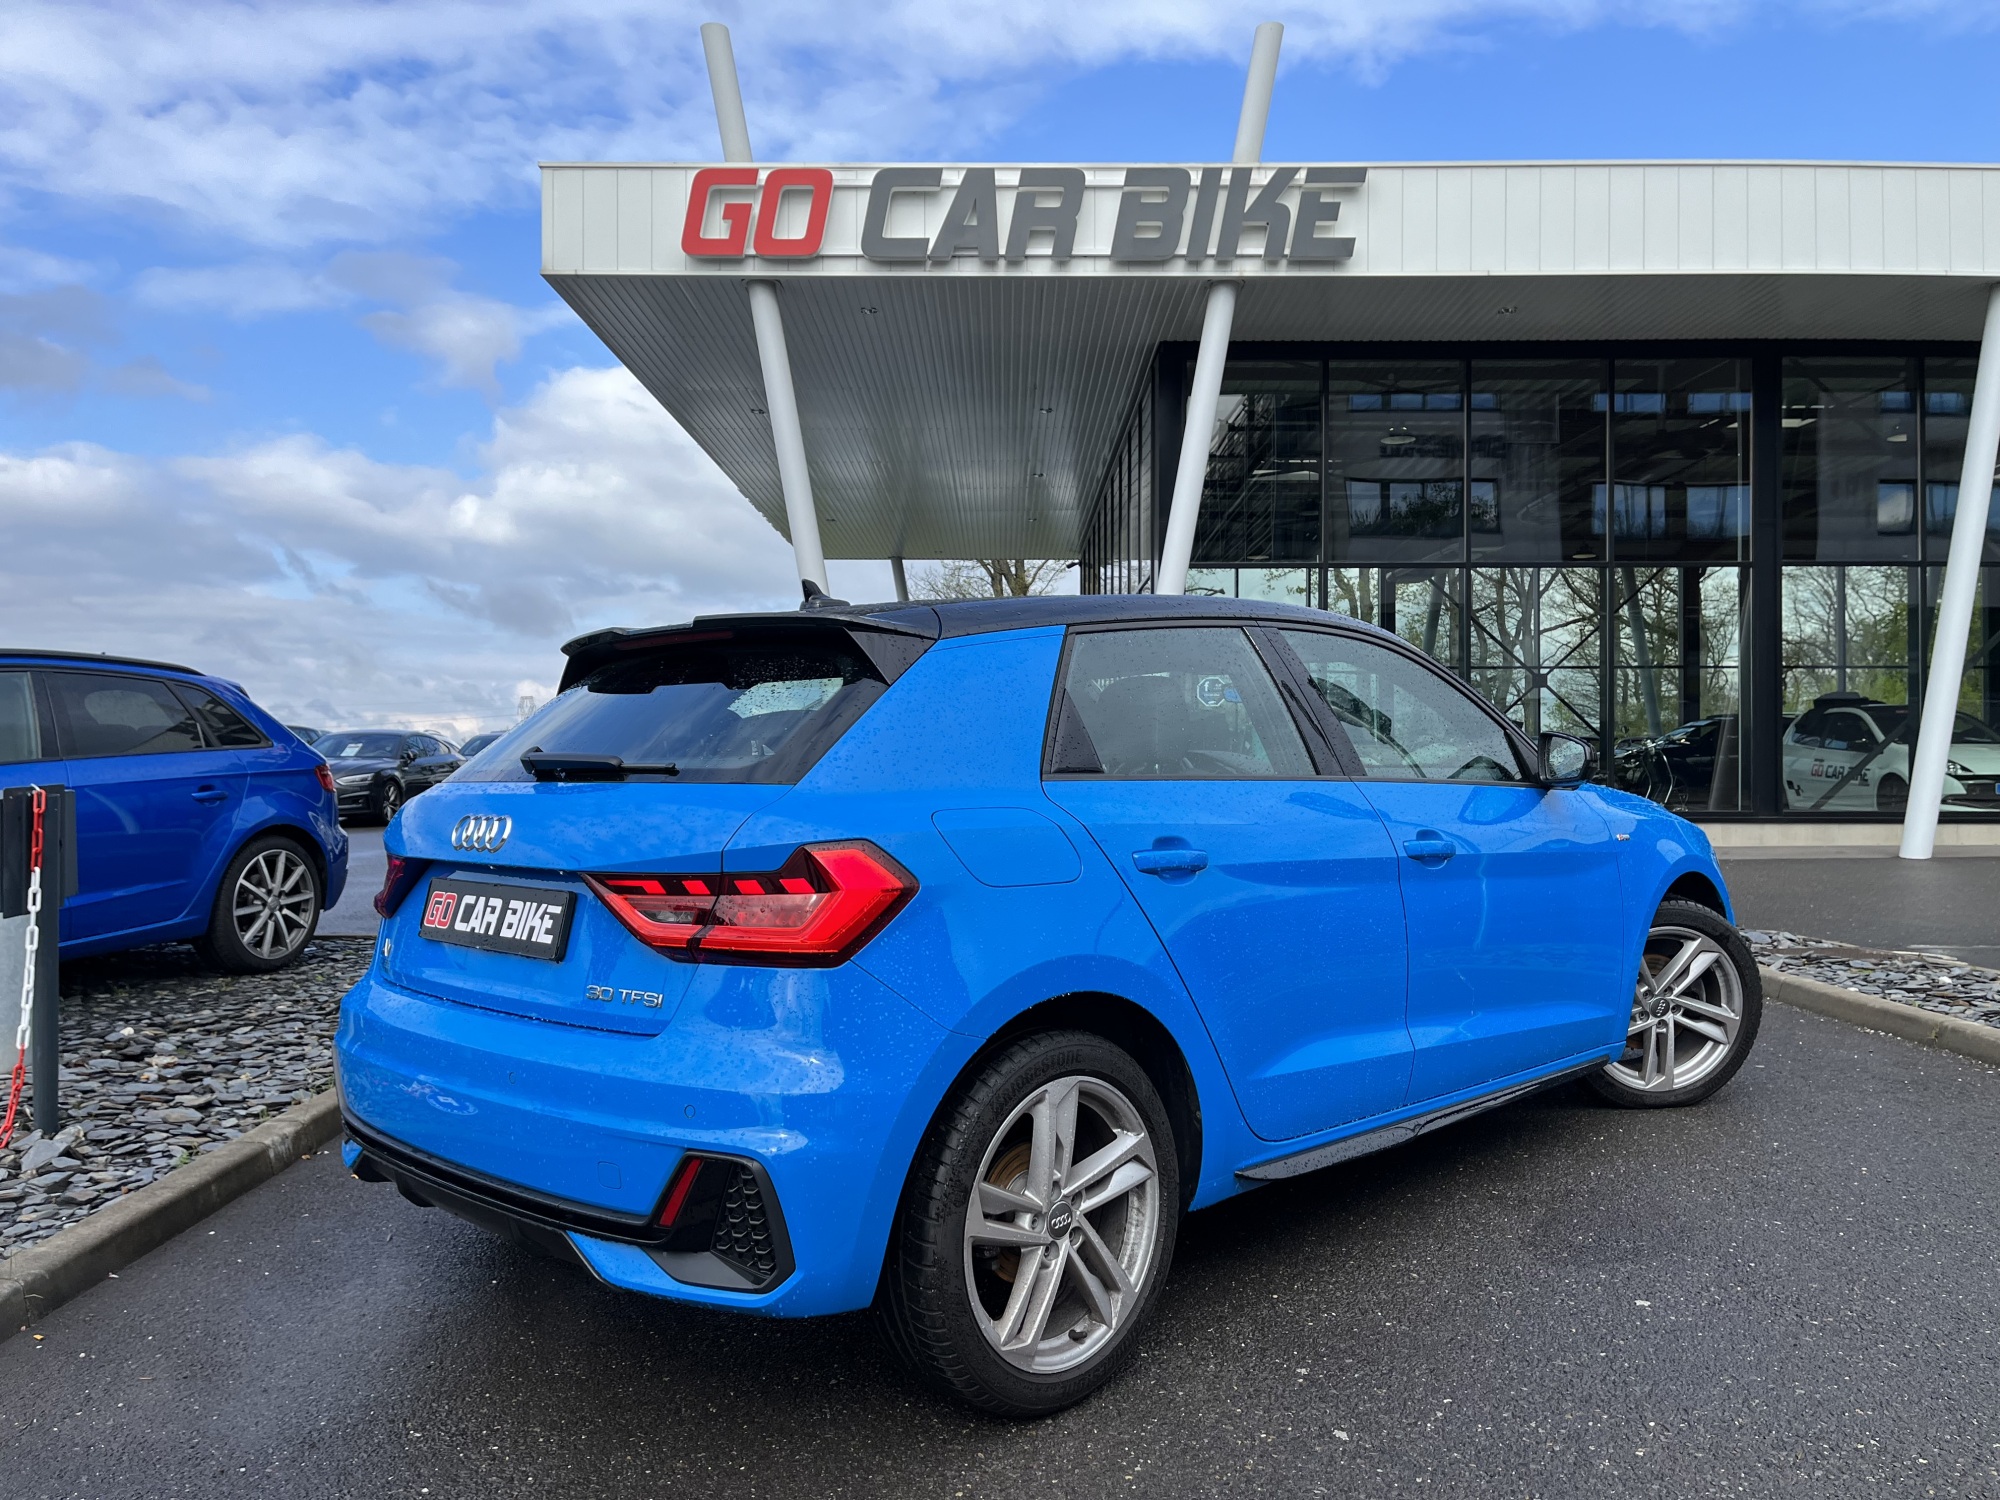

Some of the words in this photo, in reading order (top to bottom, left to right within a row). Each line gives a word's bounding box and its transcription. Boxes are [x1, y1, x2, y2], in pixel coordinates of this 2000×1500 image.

[681, 167, 833, 259] GO
[860, 167, 1085, 262] CAR
[1109, 167, 1368, 262] BIKE
[1813, 763, 1824, 777] GO
[1825, 764, 1845, 779] CAR
[424, 891, 458, 928] GO
[454, 895, 502, 935] CAR
[499, 899, 561, 944] BIKE
[586, 985, 613, 1002] 30
[618, 988, 664, 1008] TFSI
